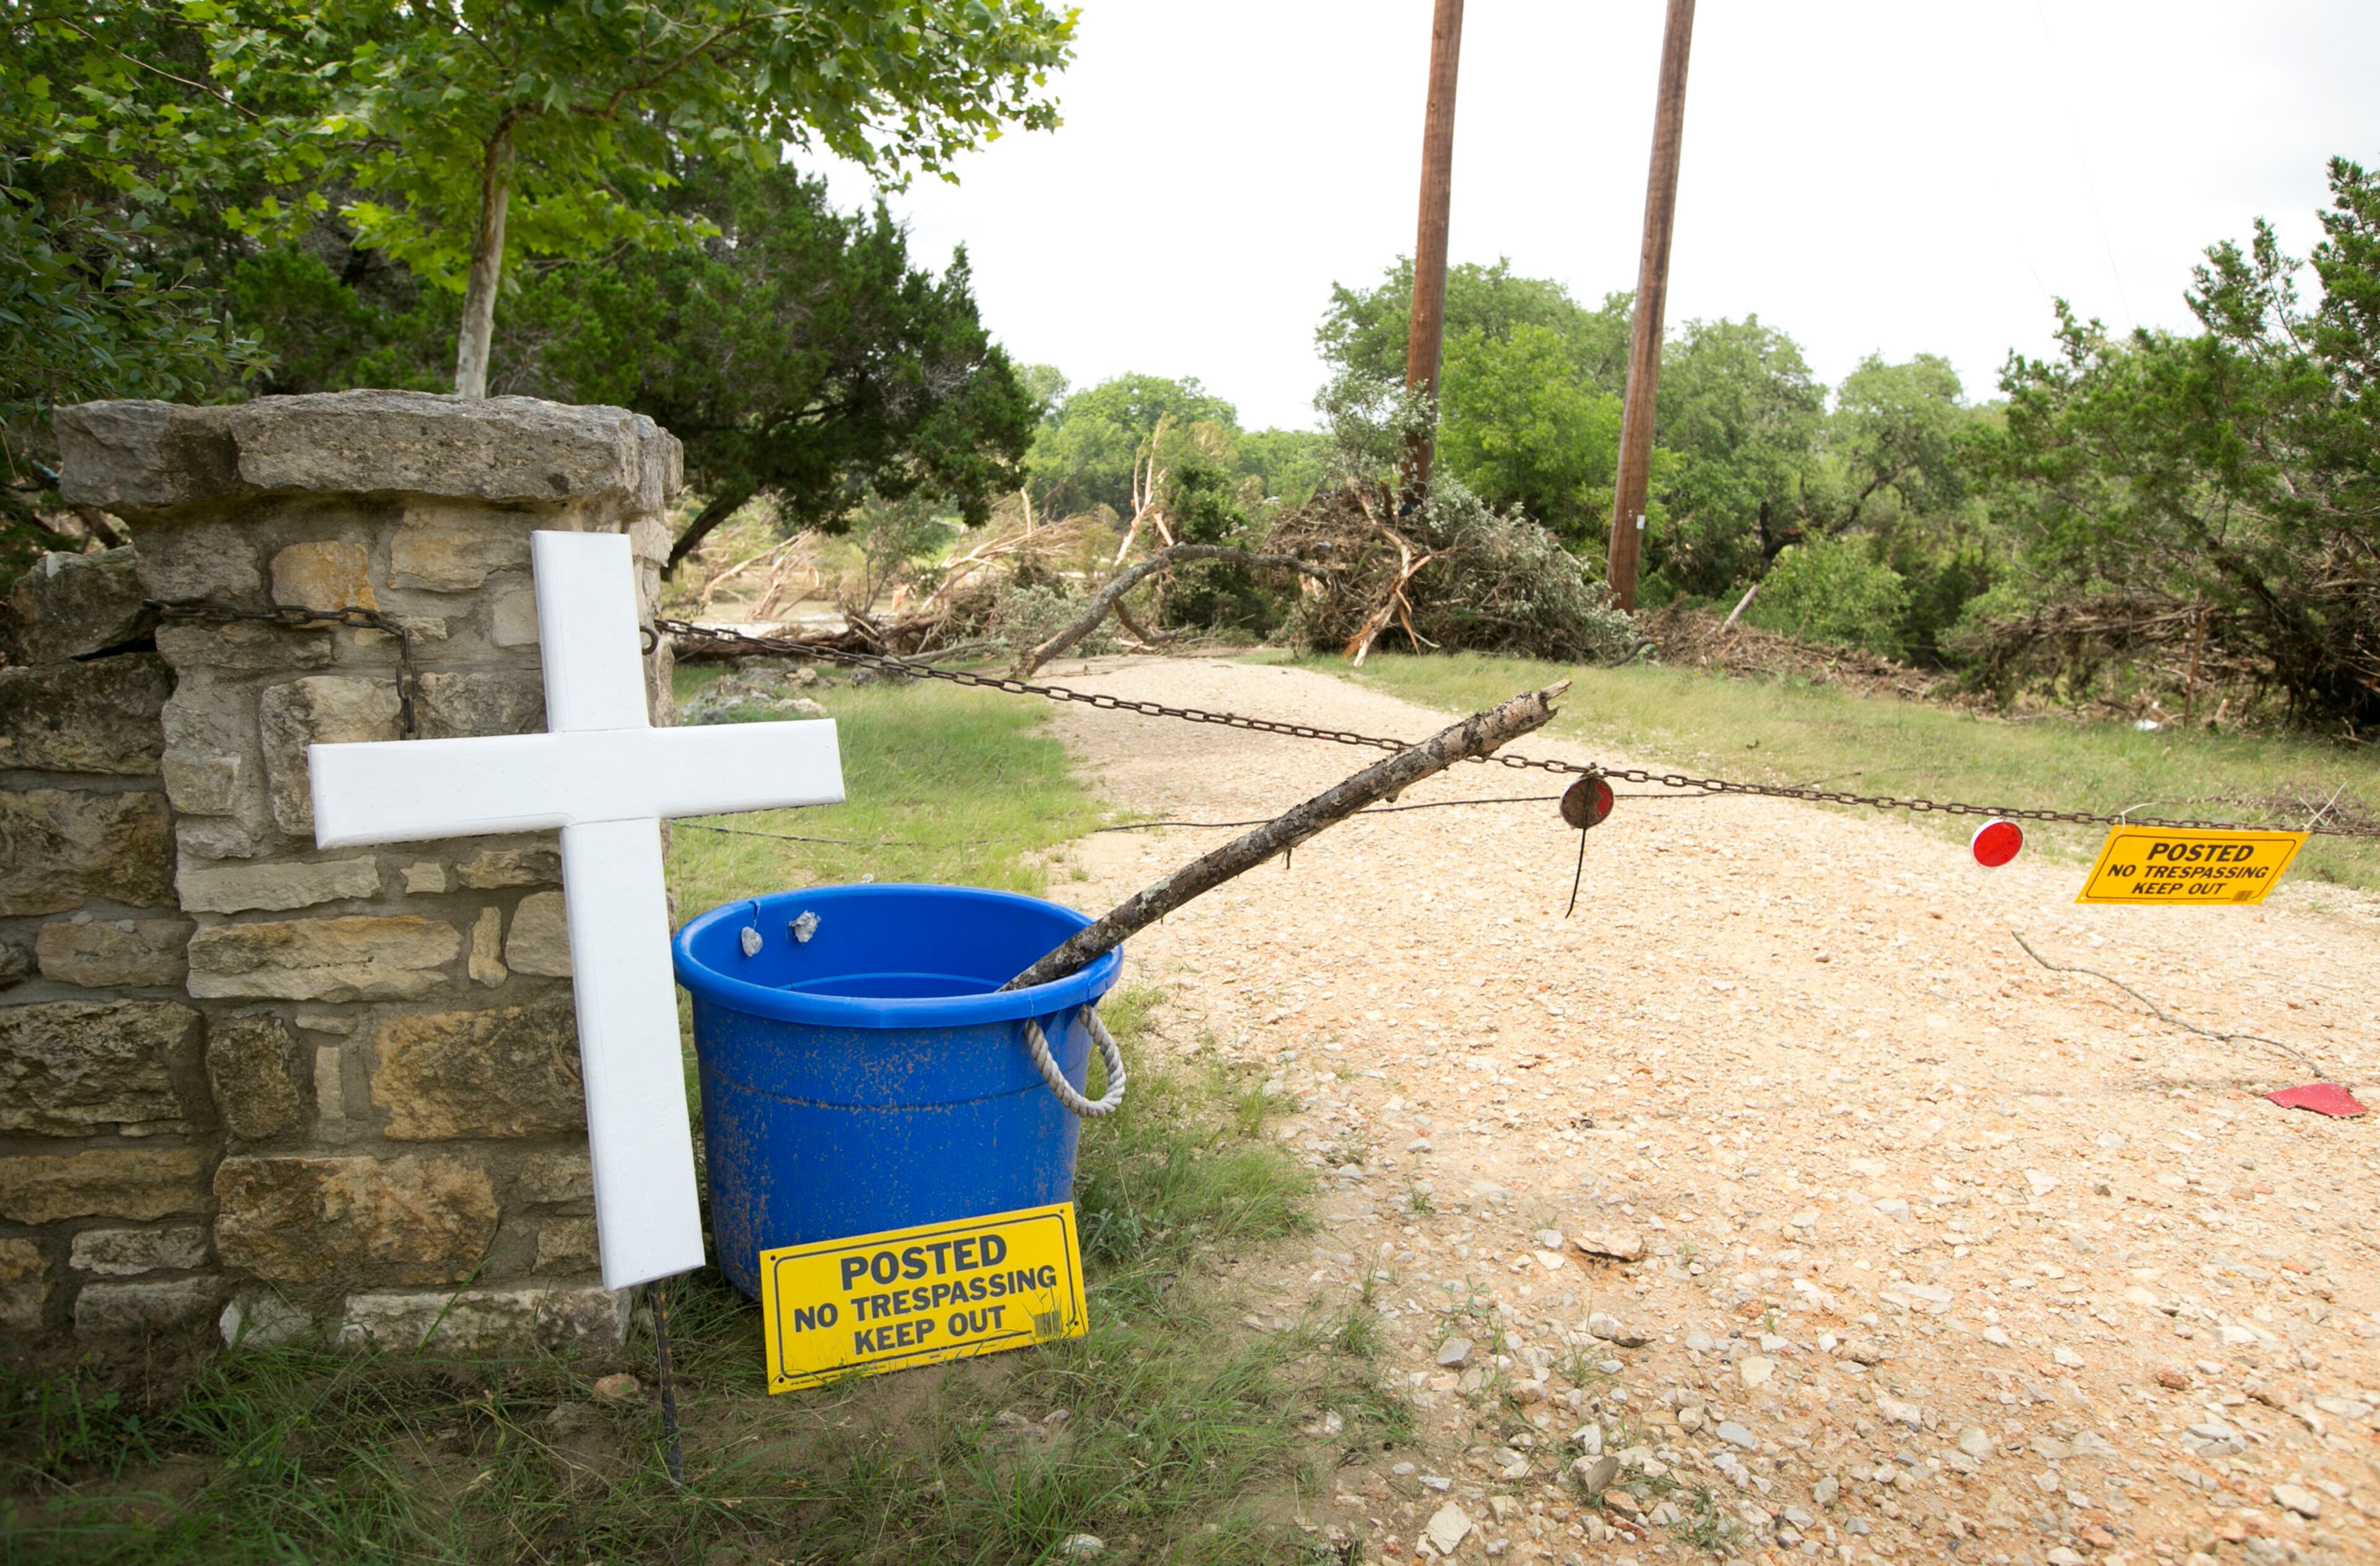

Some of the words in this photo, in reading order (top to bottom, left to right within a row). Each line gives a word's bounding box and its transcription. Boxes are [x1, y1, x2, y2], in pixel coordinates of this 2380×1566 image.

[2147, 843, 2254, 862] POSTED
[2107, 864, 2136, 877] NO
[2144, 865, 2270, 878] TRESPASSING
[2131, 882, 2184, 895] KEEP
[2188, 883, 2227, 895] OUT
[840, 1234, 1007, 1291] POSTED
[794, 1303, 838, 1333] NO
[850, 1265, 1057, 1322] TRESPASSING
[854, 1319, 935, 1355] KEEP
[948, 1304, 1006, 1337] OUT
